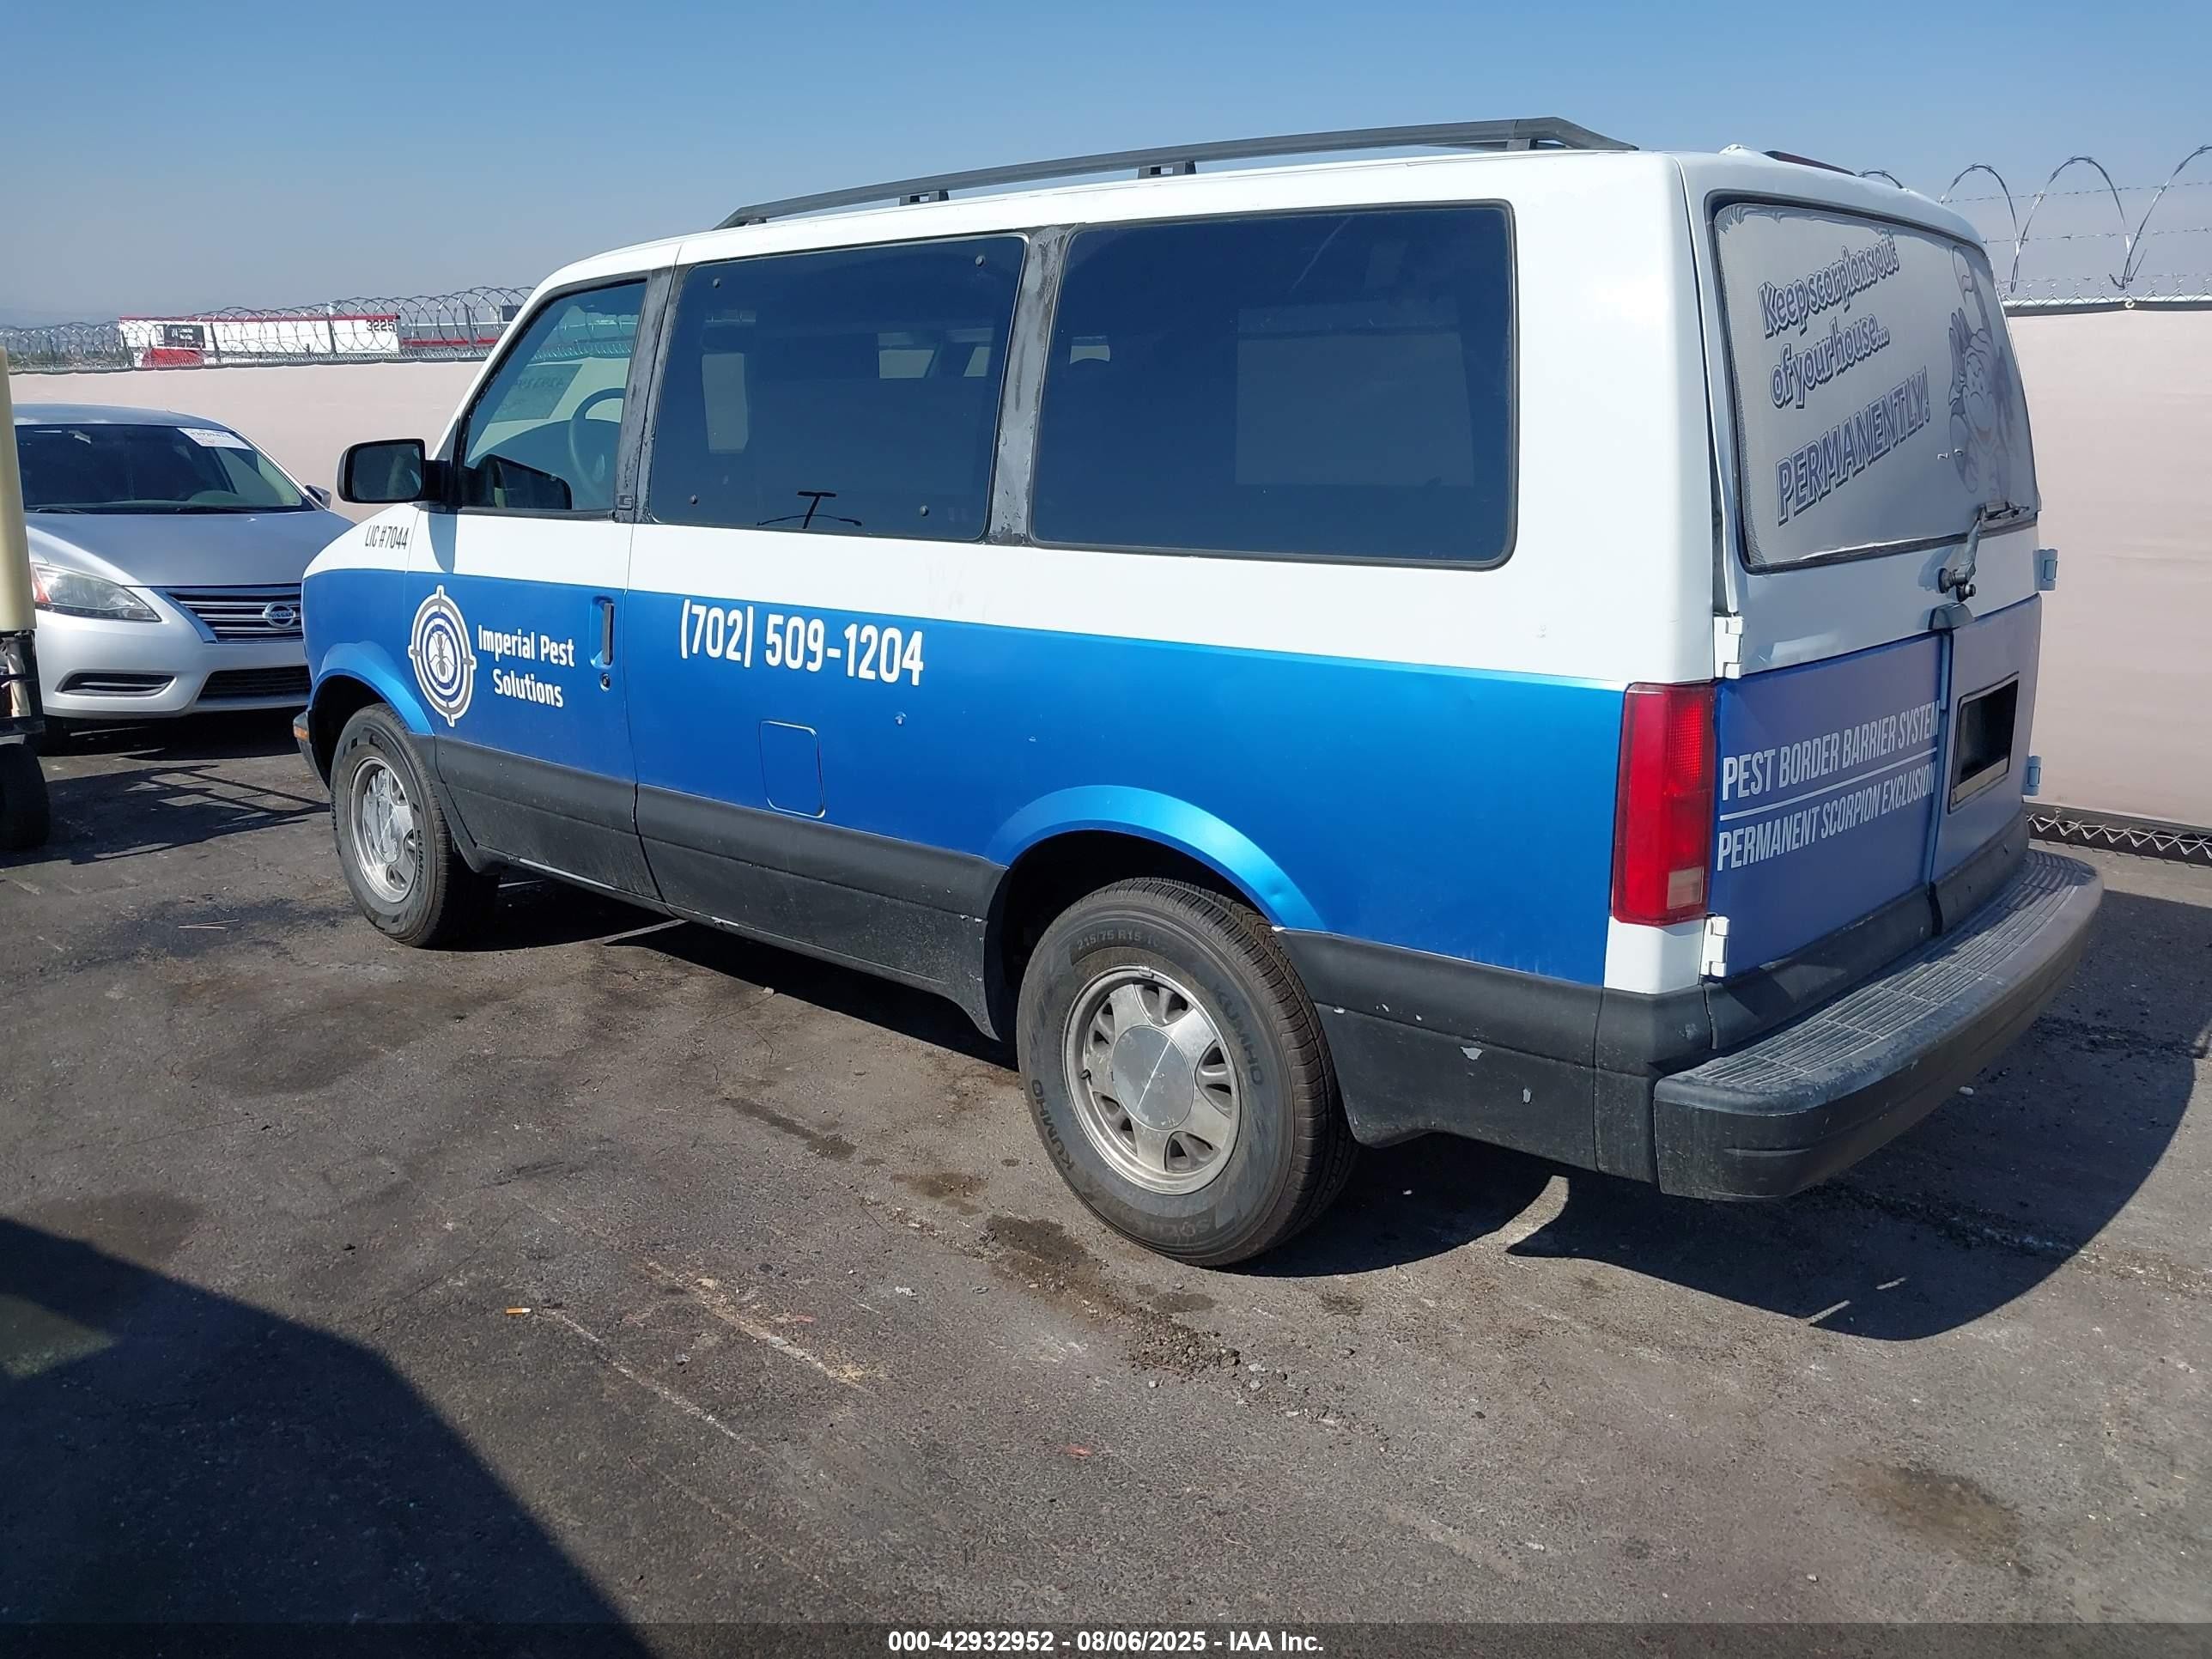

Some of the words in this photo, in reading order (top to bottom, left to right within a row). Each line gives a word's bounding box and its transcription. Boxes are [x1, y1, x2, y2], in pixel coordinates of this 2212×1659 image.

[1758, 282, 1808, 339] Keep
[1807, 246, 1877, 313] scorpions
[1873, 228, 1899, 279] out
[1771, 343, 1793, 409] of
[1791, 336, 1833, 409] your
[1776, 365, 1929, 526] PERMANENTLY!
[365, 525, 380, 548] LIC
[379, 525, 409, 550] #7044
[477, 624, 535, 662] Imperial
[540, 635, 575, 667] Pest
[680, 599, 754, 668] (702)
[765, 613, 925, 686] 509-1204
[493, 668, 564, 708] Solutions
[1723, 749, 1776, 800] PEST
[1779, 732, 1839, 788] BORDER
[1842, 714, 1896, 769] BARRIER
[1898, 700, 1940, 749] SYSTEM
[1717, 805, 1820, 872] PERMANENT
[1820, 783, 1881, 839] SCORPION
[1881, 762, 1936, 815] EXCLUSION
[1031, 1079, 1075, 1170] KUMHO
